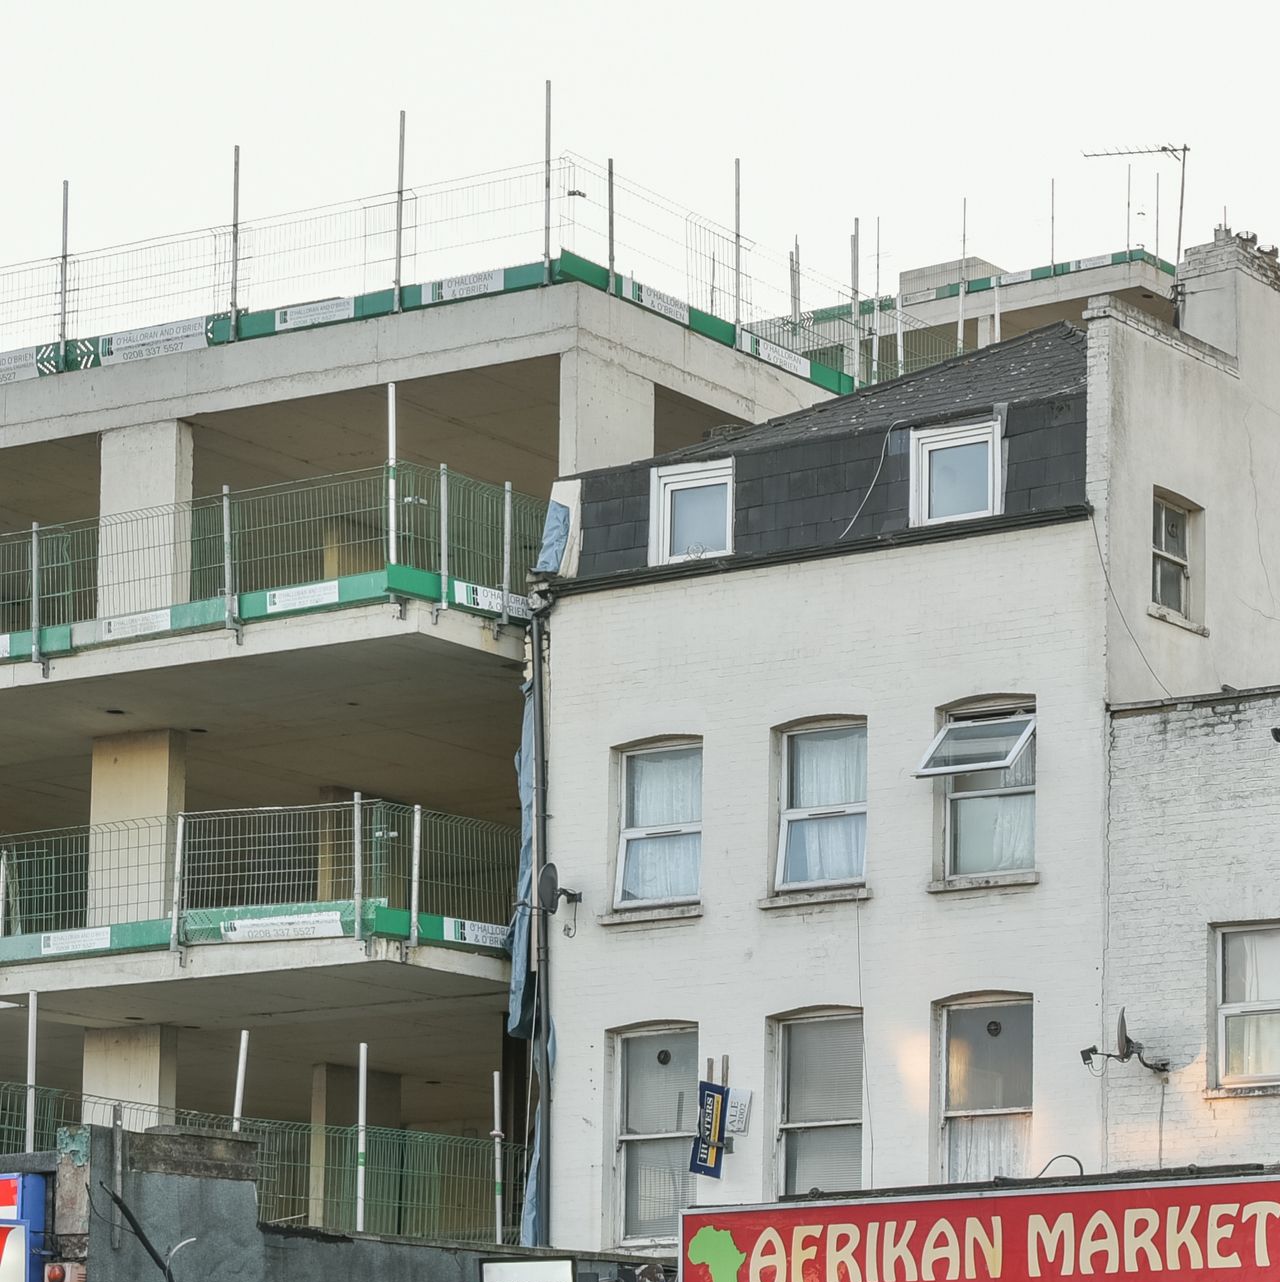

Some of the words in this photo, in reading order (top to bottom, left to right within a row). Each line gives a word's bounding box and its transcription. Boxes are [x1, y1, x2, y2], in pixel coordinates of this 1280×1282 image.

[447, 272, 494, 289] O'HALLORAN
[451, 288, 458, 298] &
[459, 282, 489, 297] O'BRIEN
[116, 328, 159, 346] O'HALLORAN
[159, 326, 175, 338] AND
[175, 321, 204, 335] O'BRIEN
[122, 349, 144, 361] 0208
[145, 346, 163, 358] 337
[163, 342, 185, 355] 5527
